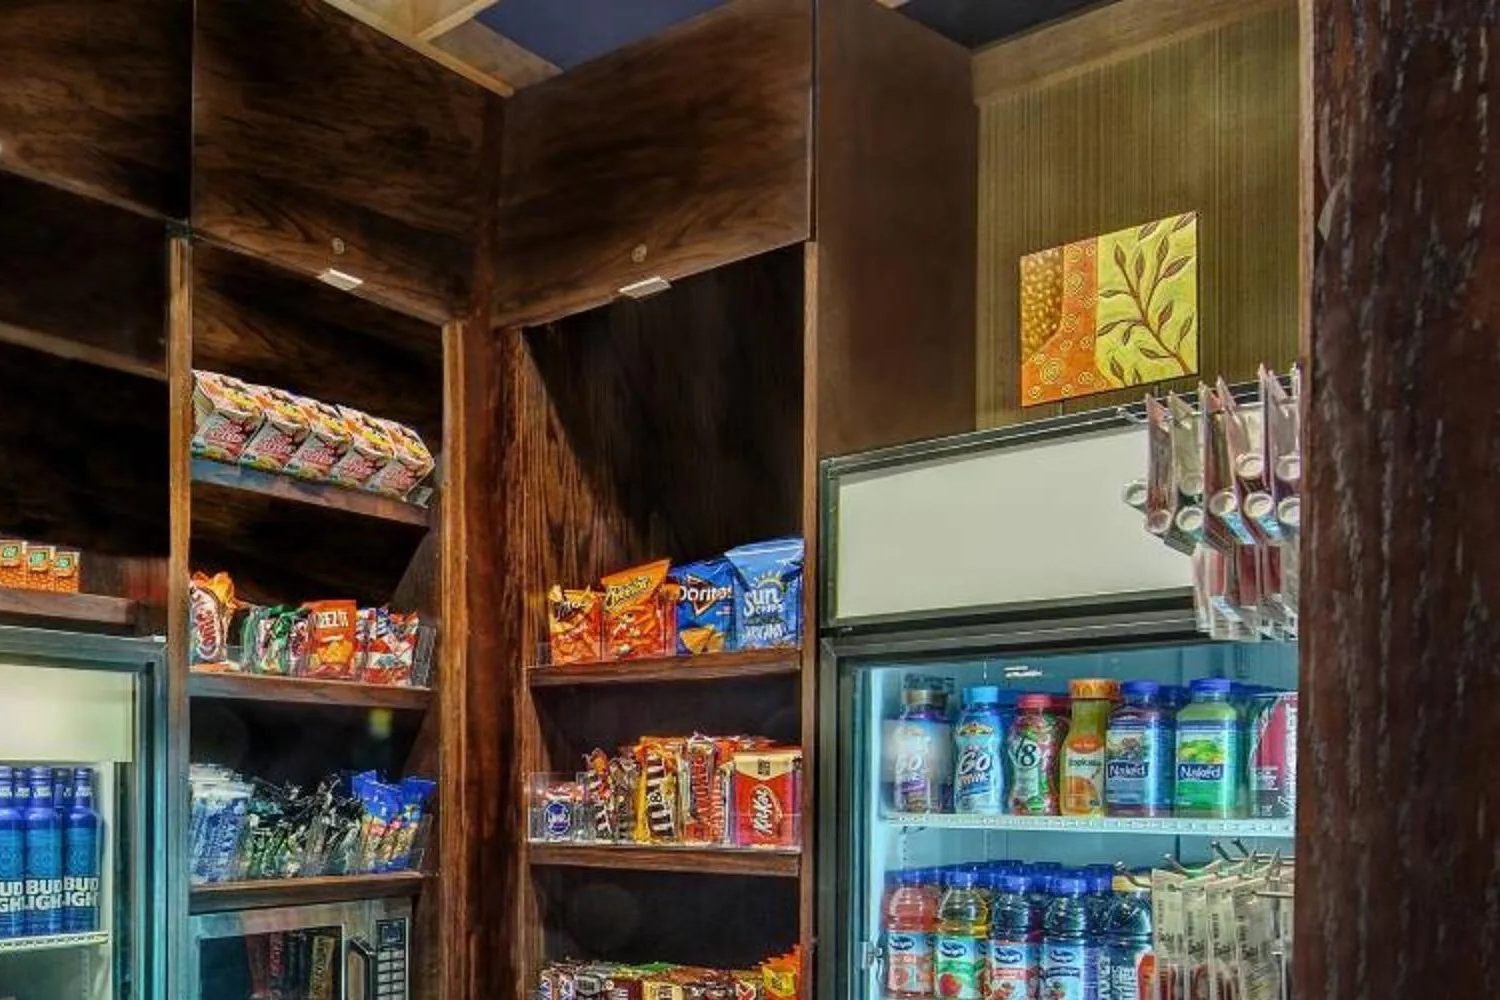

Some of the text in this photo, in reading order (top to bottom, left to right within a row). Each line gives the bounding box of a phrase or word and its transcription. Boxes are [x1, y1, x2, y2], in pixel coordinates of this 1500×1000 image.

[1109, 763, 1146, 778] Naked
[1179, 764, 1221, 780] Naked
[24, 894, 62, 911] IGH
[63, 891, 98, 907] IGH
